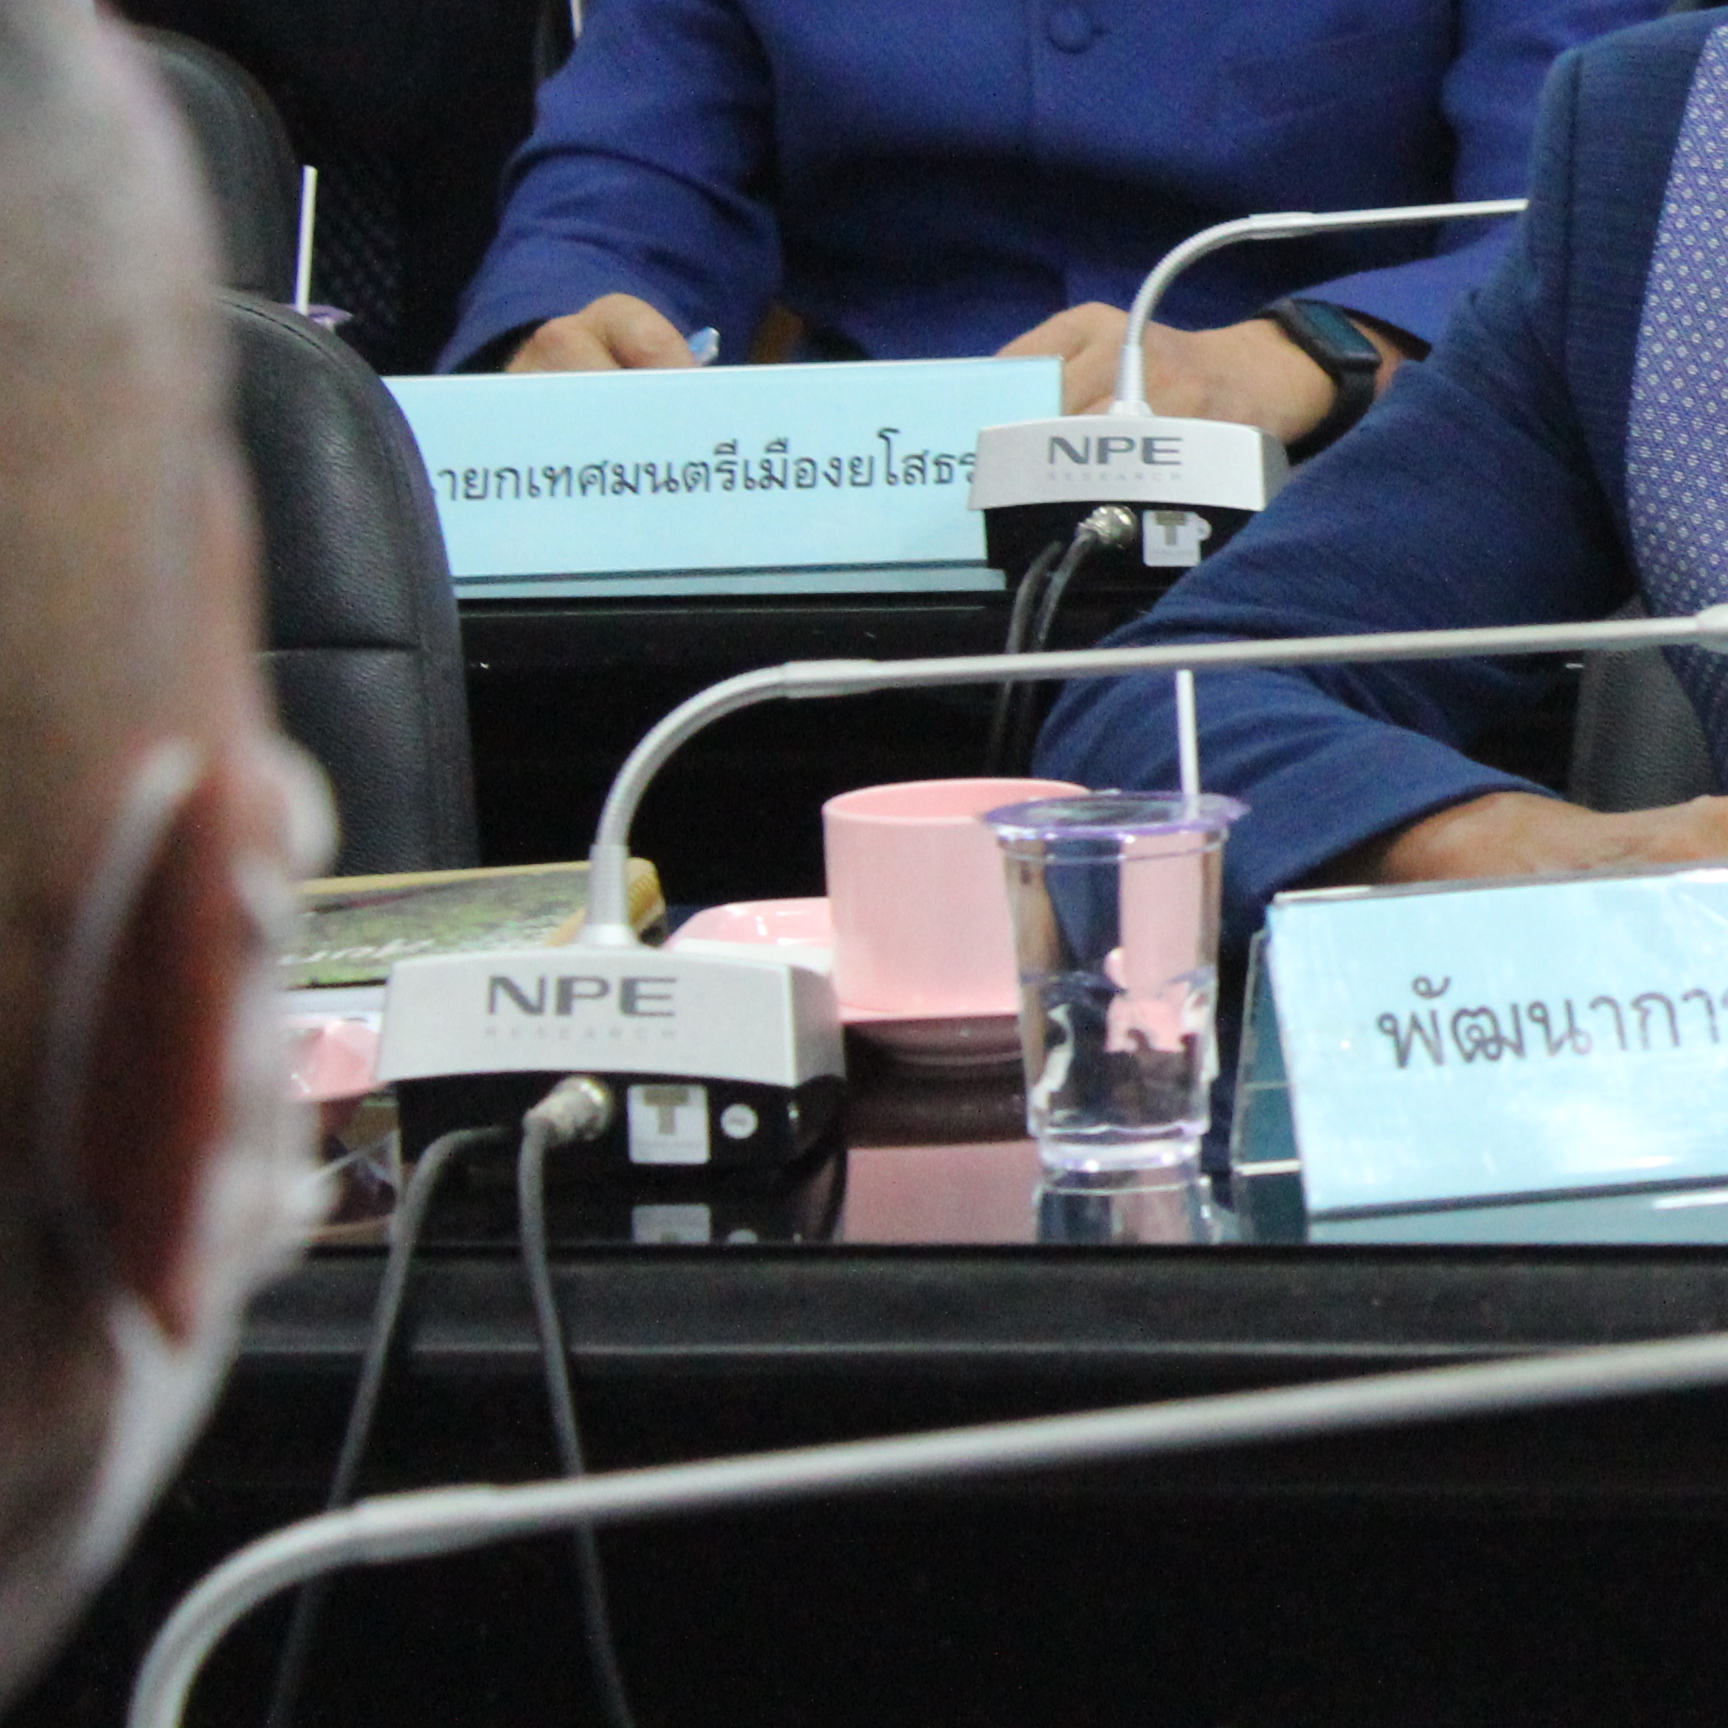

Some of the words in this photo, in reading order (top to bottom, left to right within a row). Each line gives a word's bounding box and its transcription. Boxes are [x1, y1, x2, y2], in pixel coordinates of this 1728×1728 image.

[437, 427, 977, 502] ายกเทศมนตรีเมืองยโสธร
[1047, 435, 1184, 466] NPE
[486, 975, 678, 1018] NPE
